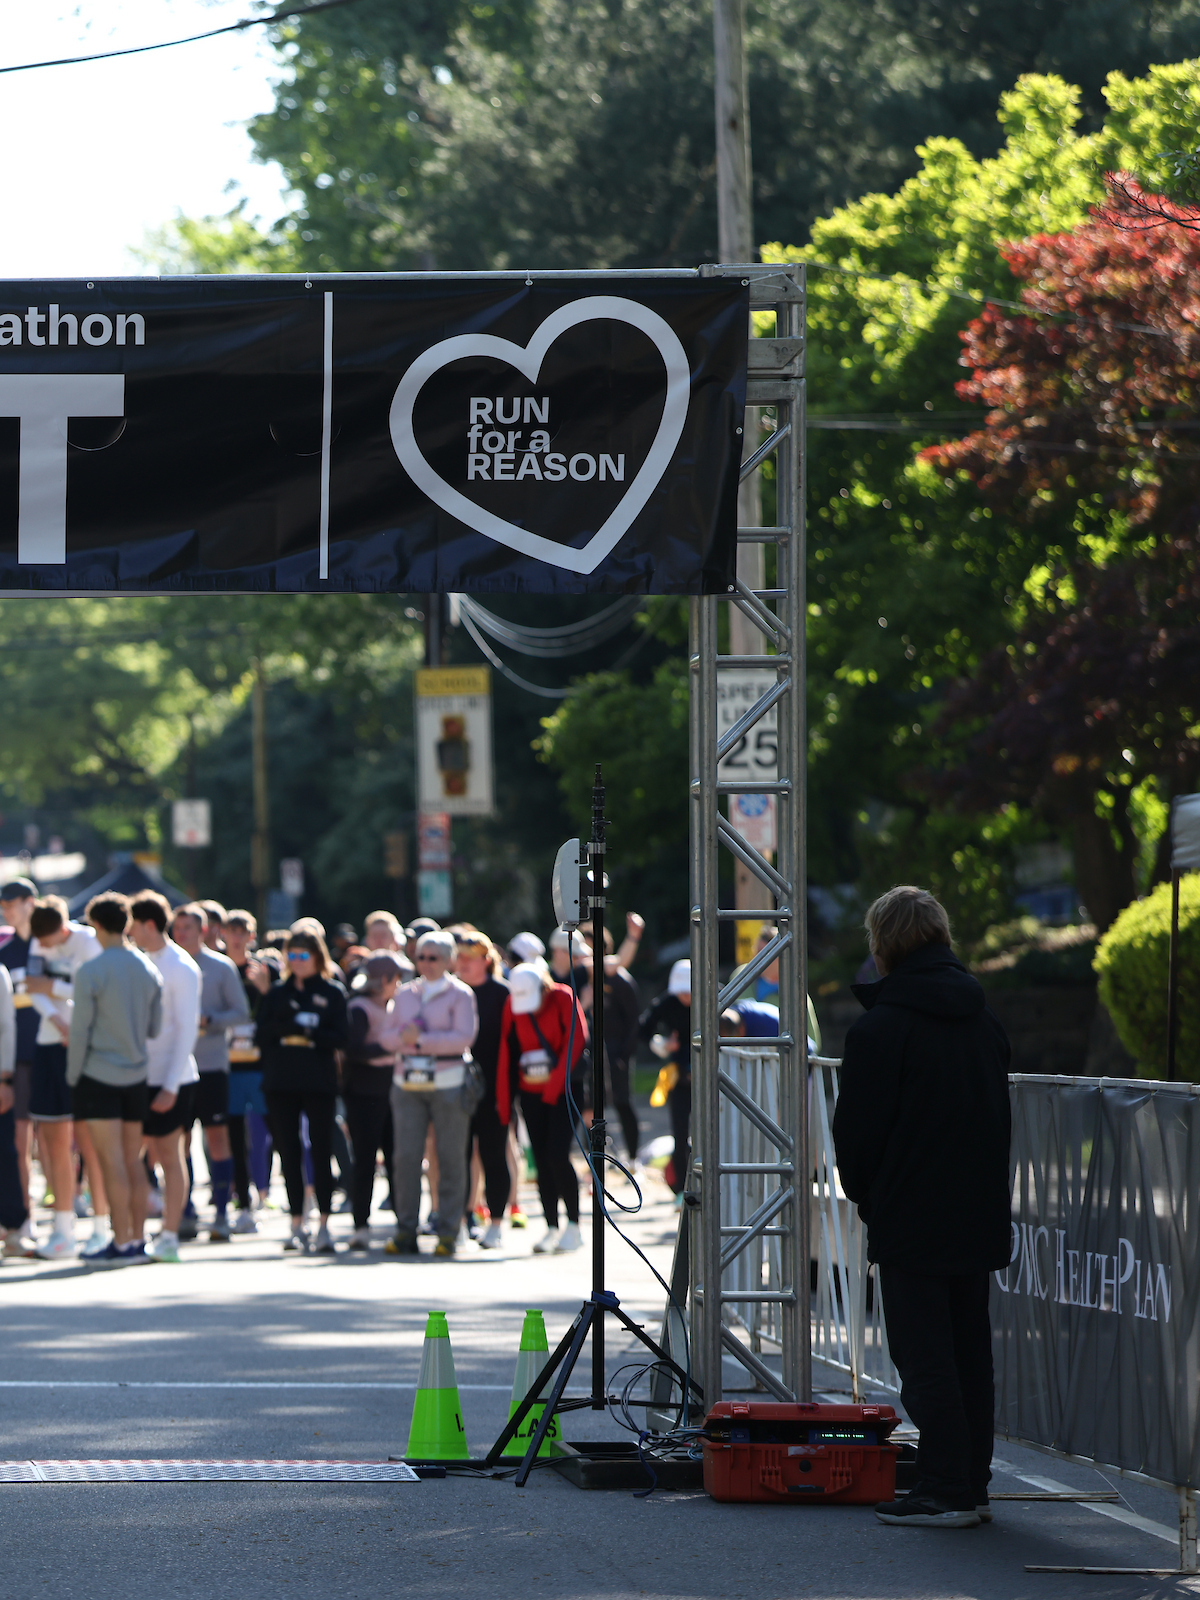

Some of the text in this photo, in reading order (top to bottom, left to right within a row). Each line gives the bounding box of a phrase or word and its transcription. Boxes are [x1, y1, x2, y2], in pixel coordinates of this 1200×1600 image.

[469, 396, 550, 424] RUN
[466, 424, 551, 453] for a
[467, 453, 626, 482] REASON
[723, 731, 778, 768] 25
